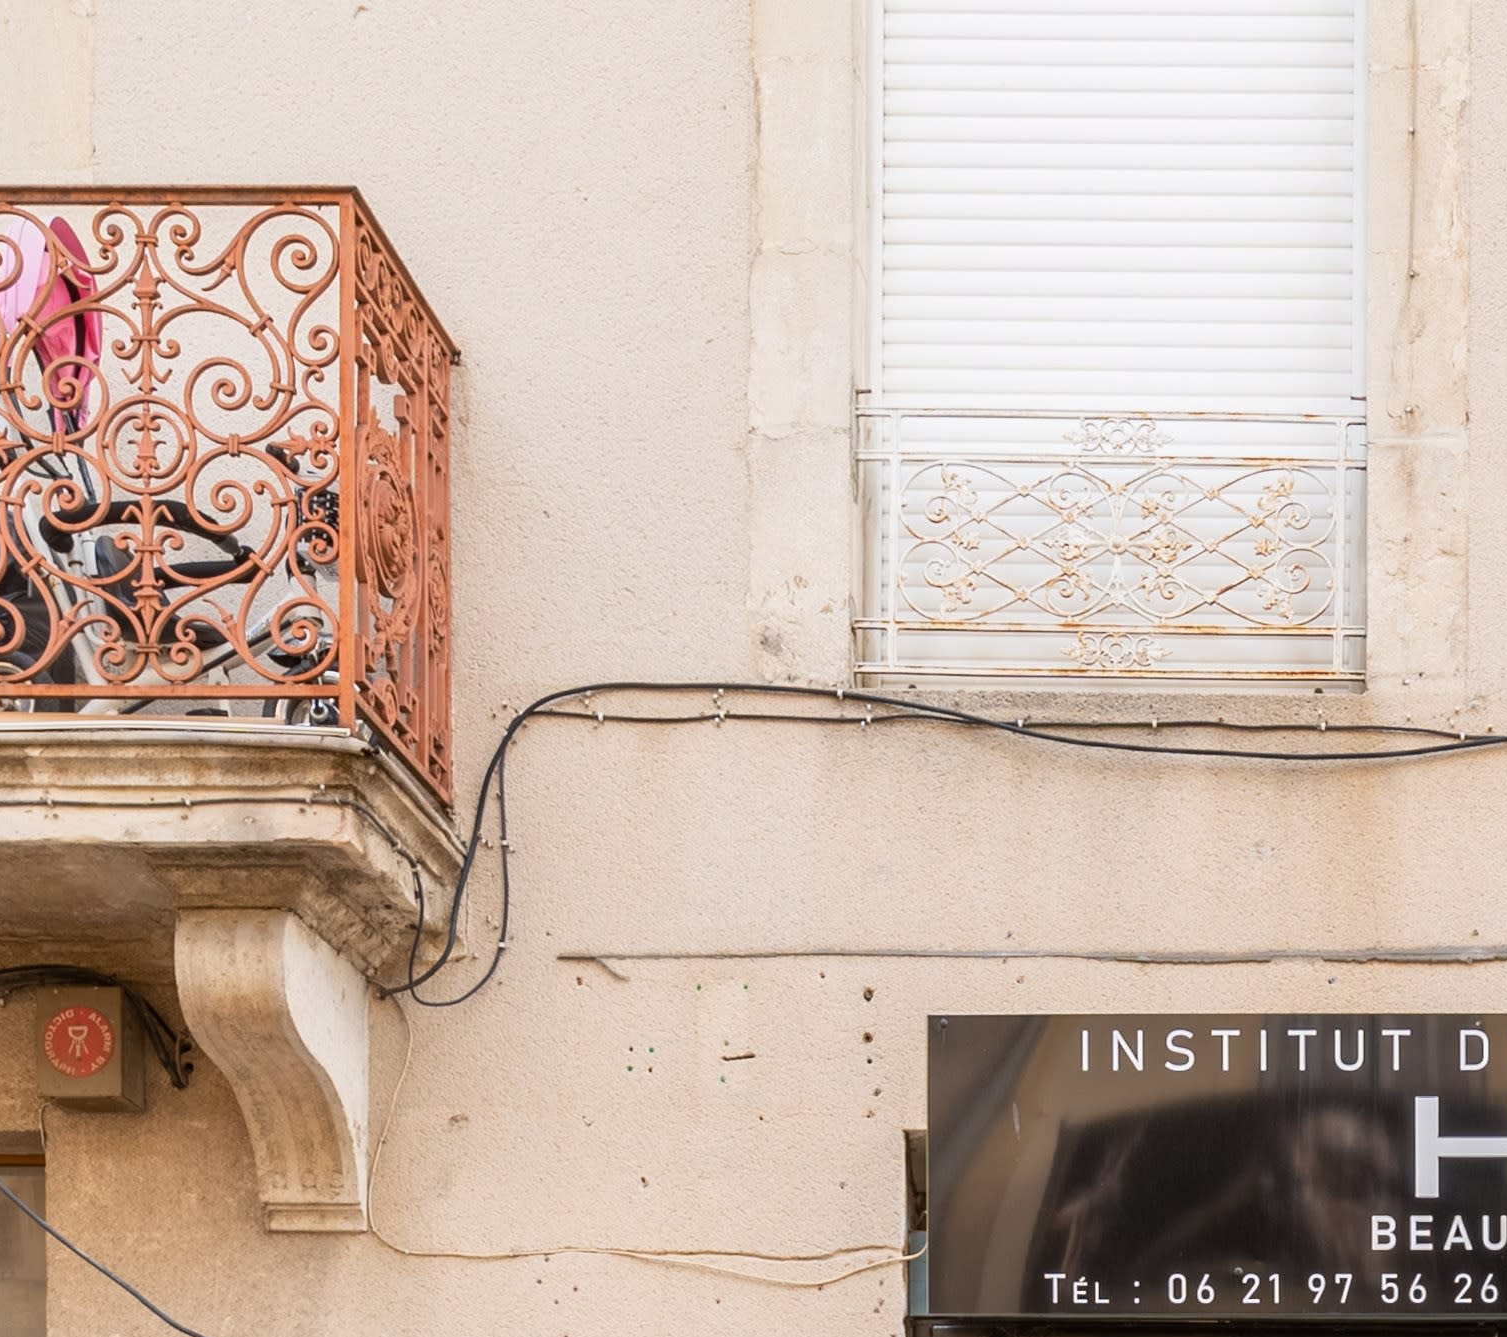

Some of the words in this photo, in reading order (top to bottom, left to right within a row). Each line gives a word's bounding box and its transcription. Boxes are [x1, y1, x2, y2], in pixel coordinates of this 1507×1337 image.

[88, 1011, 113, 1053] ALARM
[90, 1055, 106, 1072] BY
[1081, 1029, 1412, 1072] INSTITUT
[1167, 1273, 1216, 1304] 06
[1241, 1273, 1281, 1304] 21
[1307, 1273, 1353, 1304] 97
[1380, 1273, 1428, 1304] 56
[1453, 1273, 1500, 1304] 26
